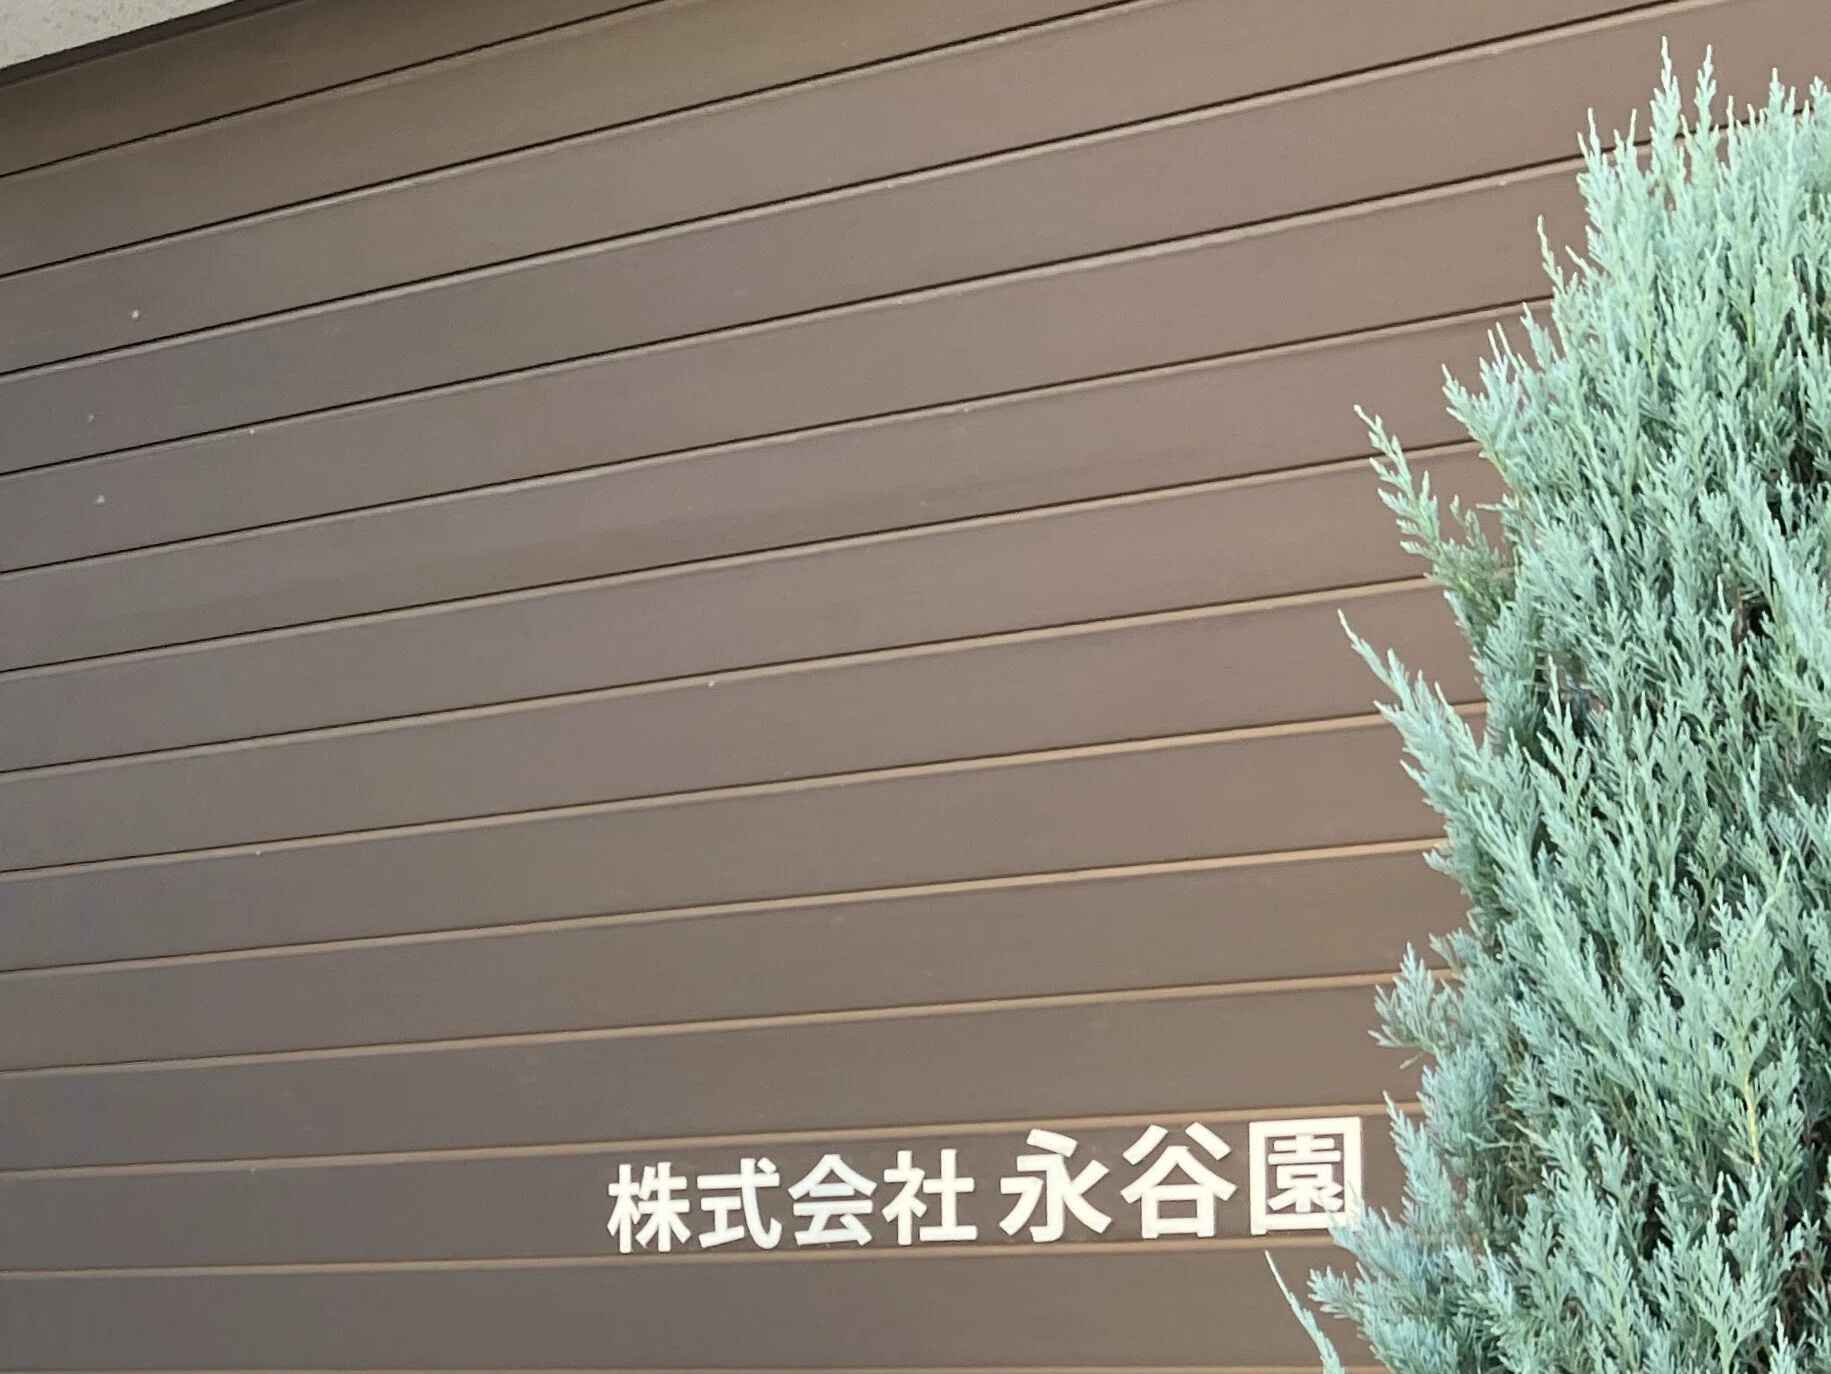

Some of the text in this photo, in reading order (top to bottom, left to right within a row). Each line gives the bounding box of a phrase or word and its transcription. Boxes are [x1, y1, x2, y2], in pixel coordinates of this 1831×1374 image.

[606, 1116, 1362, 1254] 株式会社 永谷園
